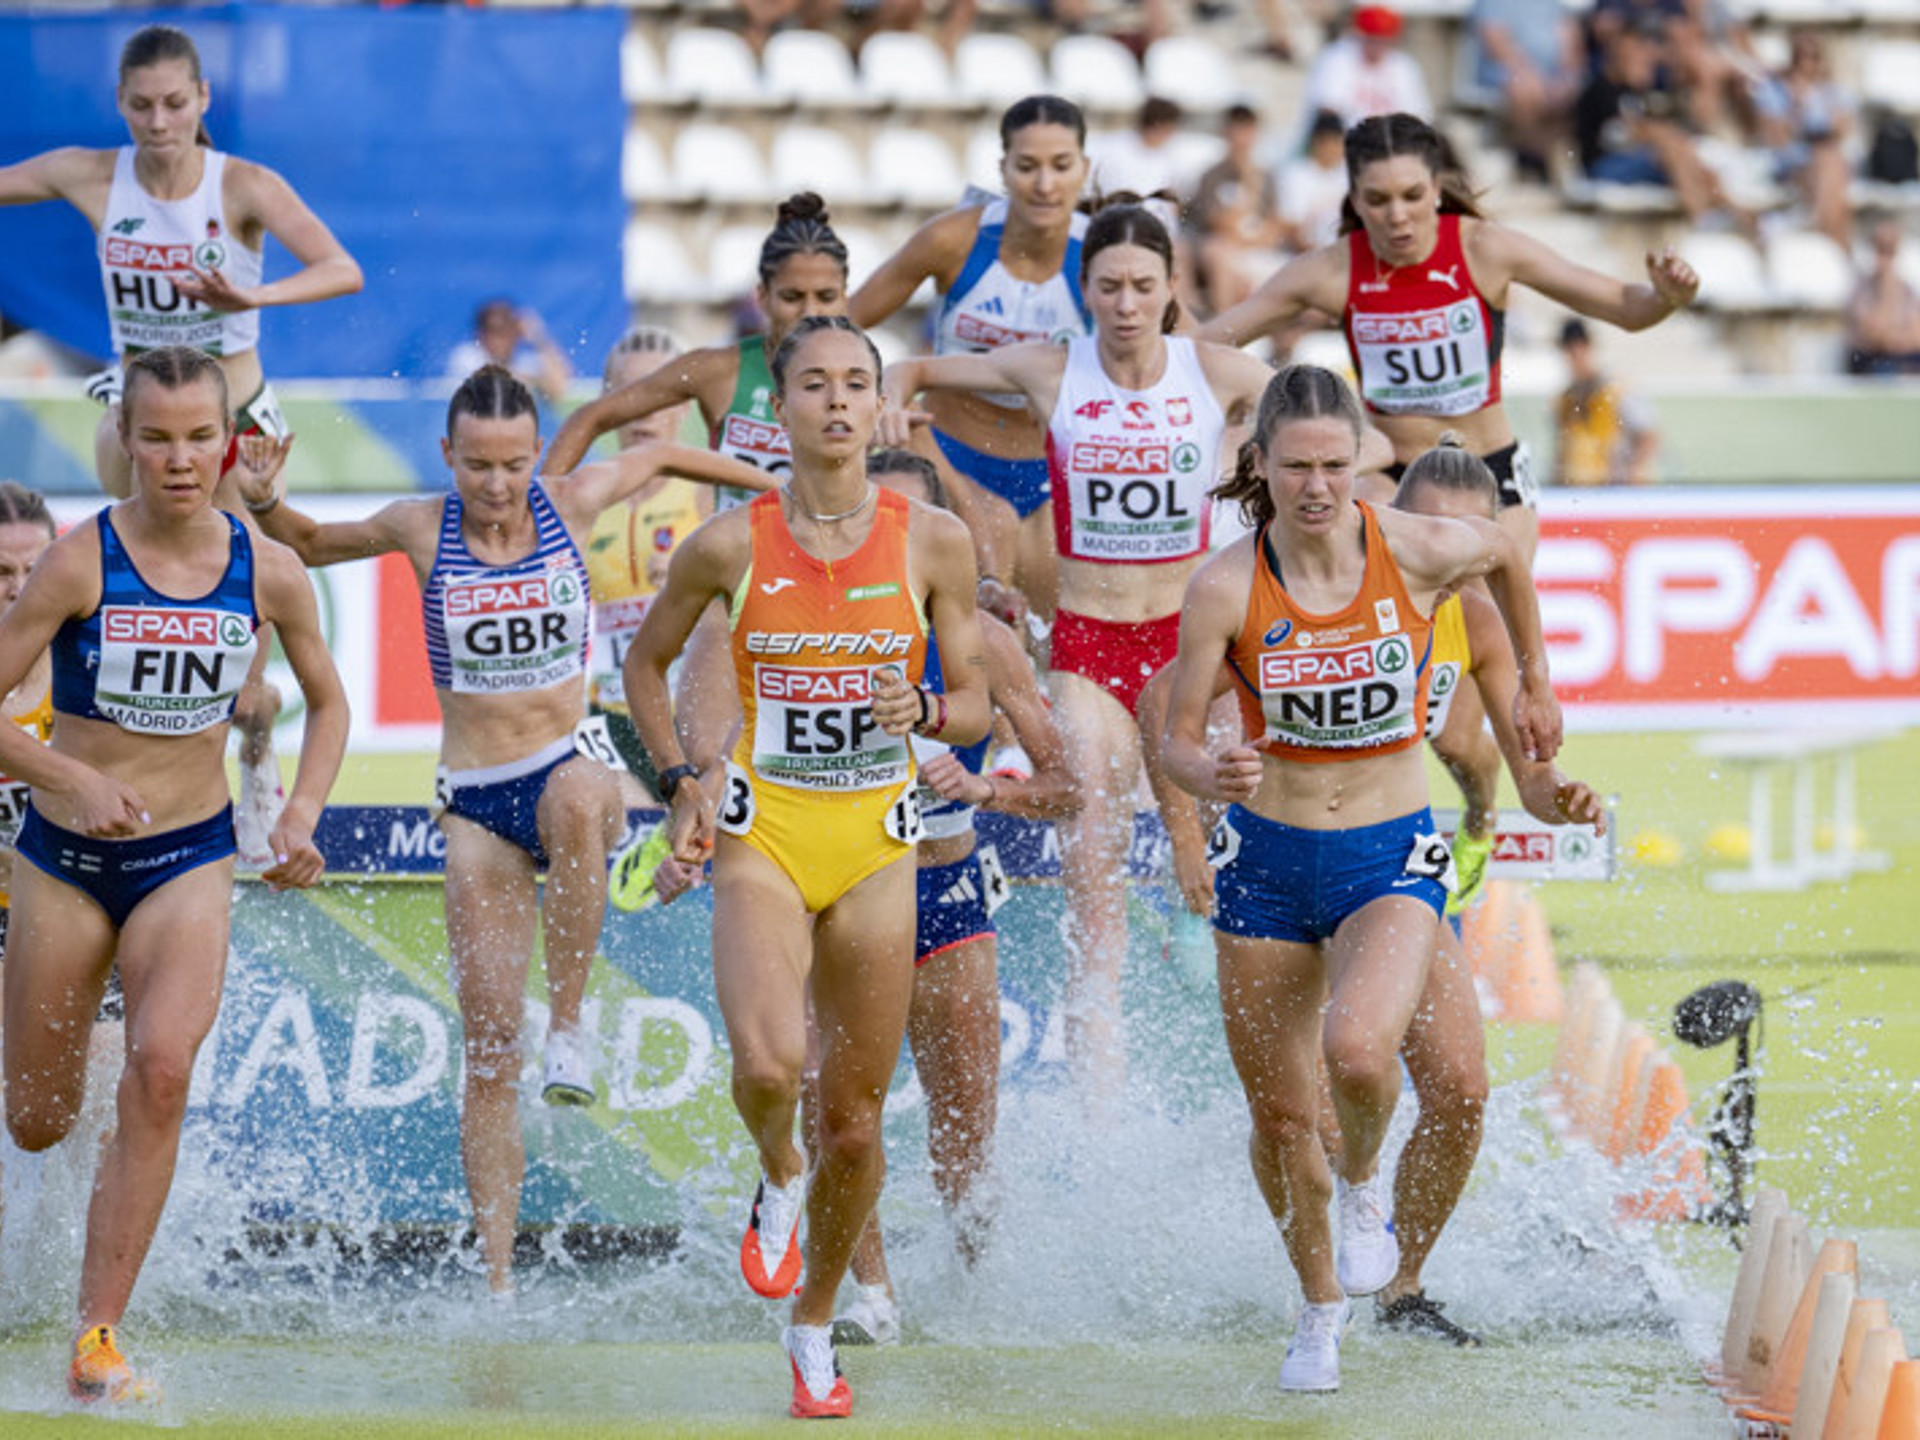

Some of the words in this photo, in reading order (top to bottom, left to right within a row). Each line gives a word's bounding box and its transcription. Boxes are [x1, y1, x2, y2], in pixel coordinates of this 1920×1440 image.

[107, 241, 191, 269] SPAR
[112, 272, 196, 312] HU
[118, 322, 181, 344] MADRID
[1358, 317, 1445, 342] SPAR
[1384, 342, 1463, 385] SUI
[730, 421, 790, 450] SPA
[1074, 446, 1167, 471] SPAR
[1087, 478, 1188, 520] POL
[1082, 537, 1151, 554] MADRID
[1154, 536, 1192, 552] 2025
[448, 583, 545, 614] SPAR
[1532, 535, 1920, 685] SPA
[108, 613, 214, 642] SPAR
[464, 611, 569, 656] GBR
[131, 649, 226, 694] FIN
[464, 672, 537, 690] MADRID
[1264, 650, 1373, 685] SPAR
[762, 671, 867, 699] SPAR
[108, 706, 189, 730] MADRID
[1280, 681, 1399, 728] NED
[579, 729, 616, 763] 15
[785, 707, 878, 754] ESP
[722, 778, 750, 825] 3
[1423, 843, 1450, 879] 9
